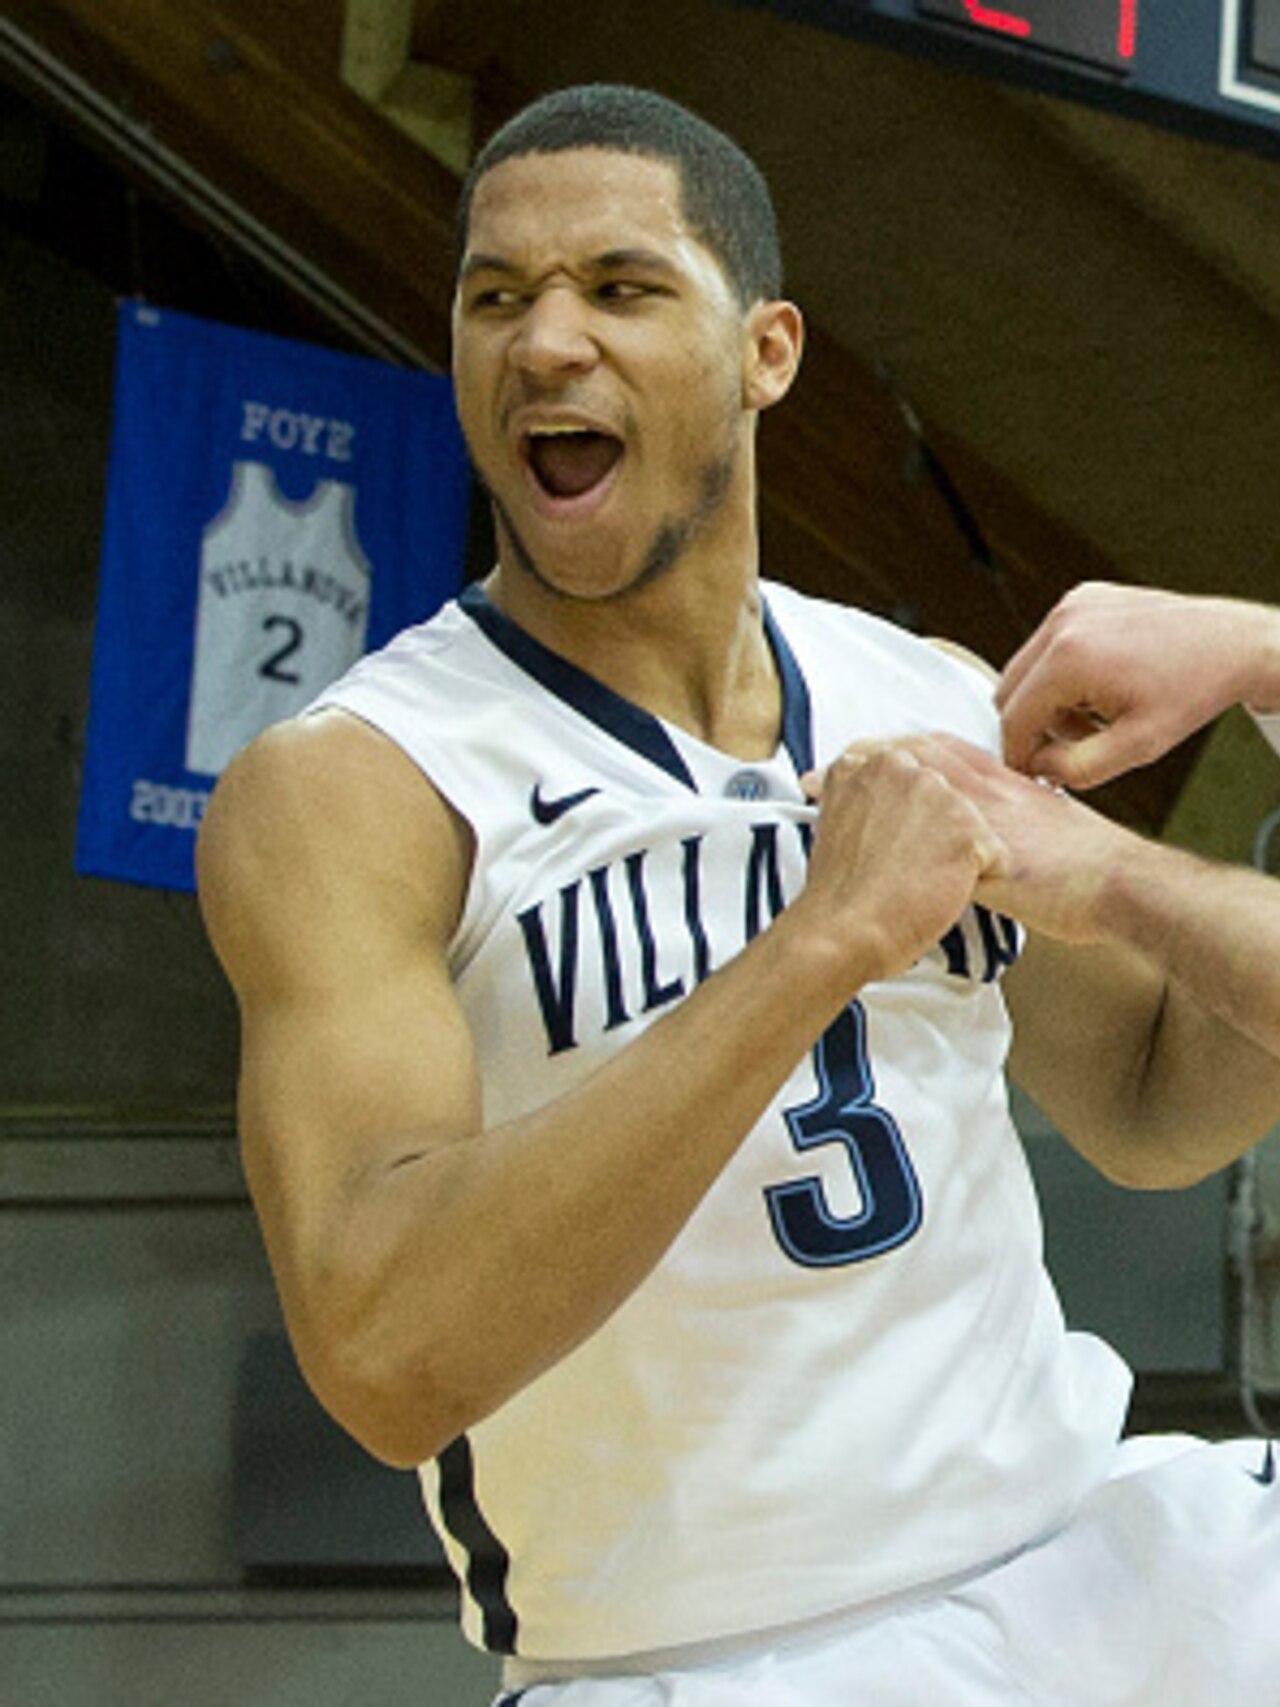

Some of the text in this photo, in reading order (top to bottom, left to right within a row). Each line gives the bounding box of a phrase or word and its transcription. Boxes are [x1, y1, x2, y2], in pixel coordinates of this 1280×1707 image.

[241, 401, 355, 463] FOYE
[209, 556, 361, 626] VILLANOVA
[259, 615, 301, 685] 2
[763, 998, 923, 1267] 3
